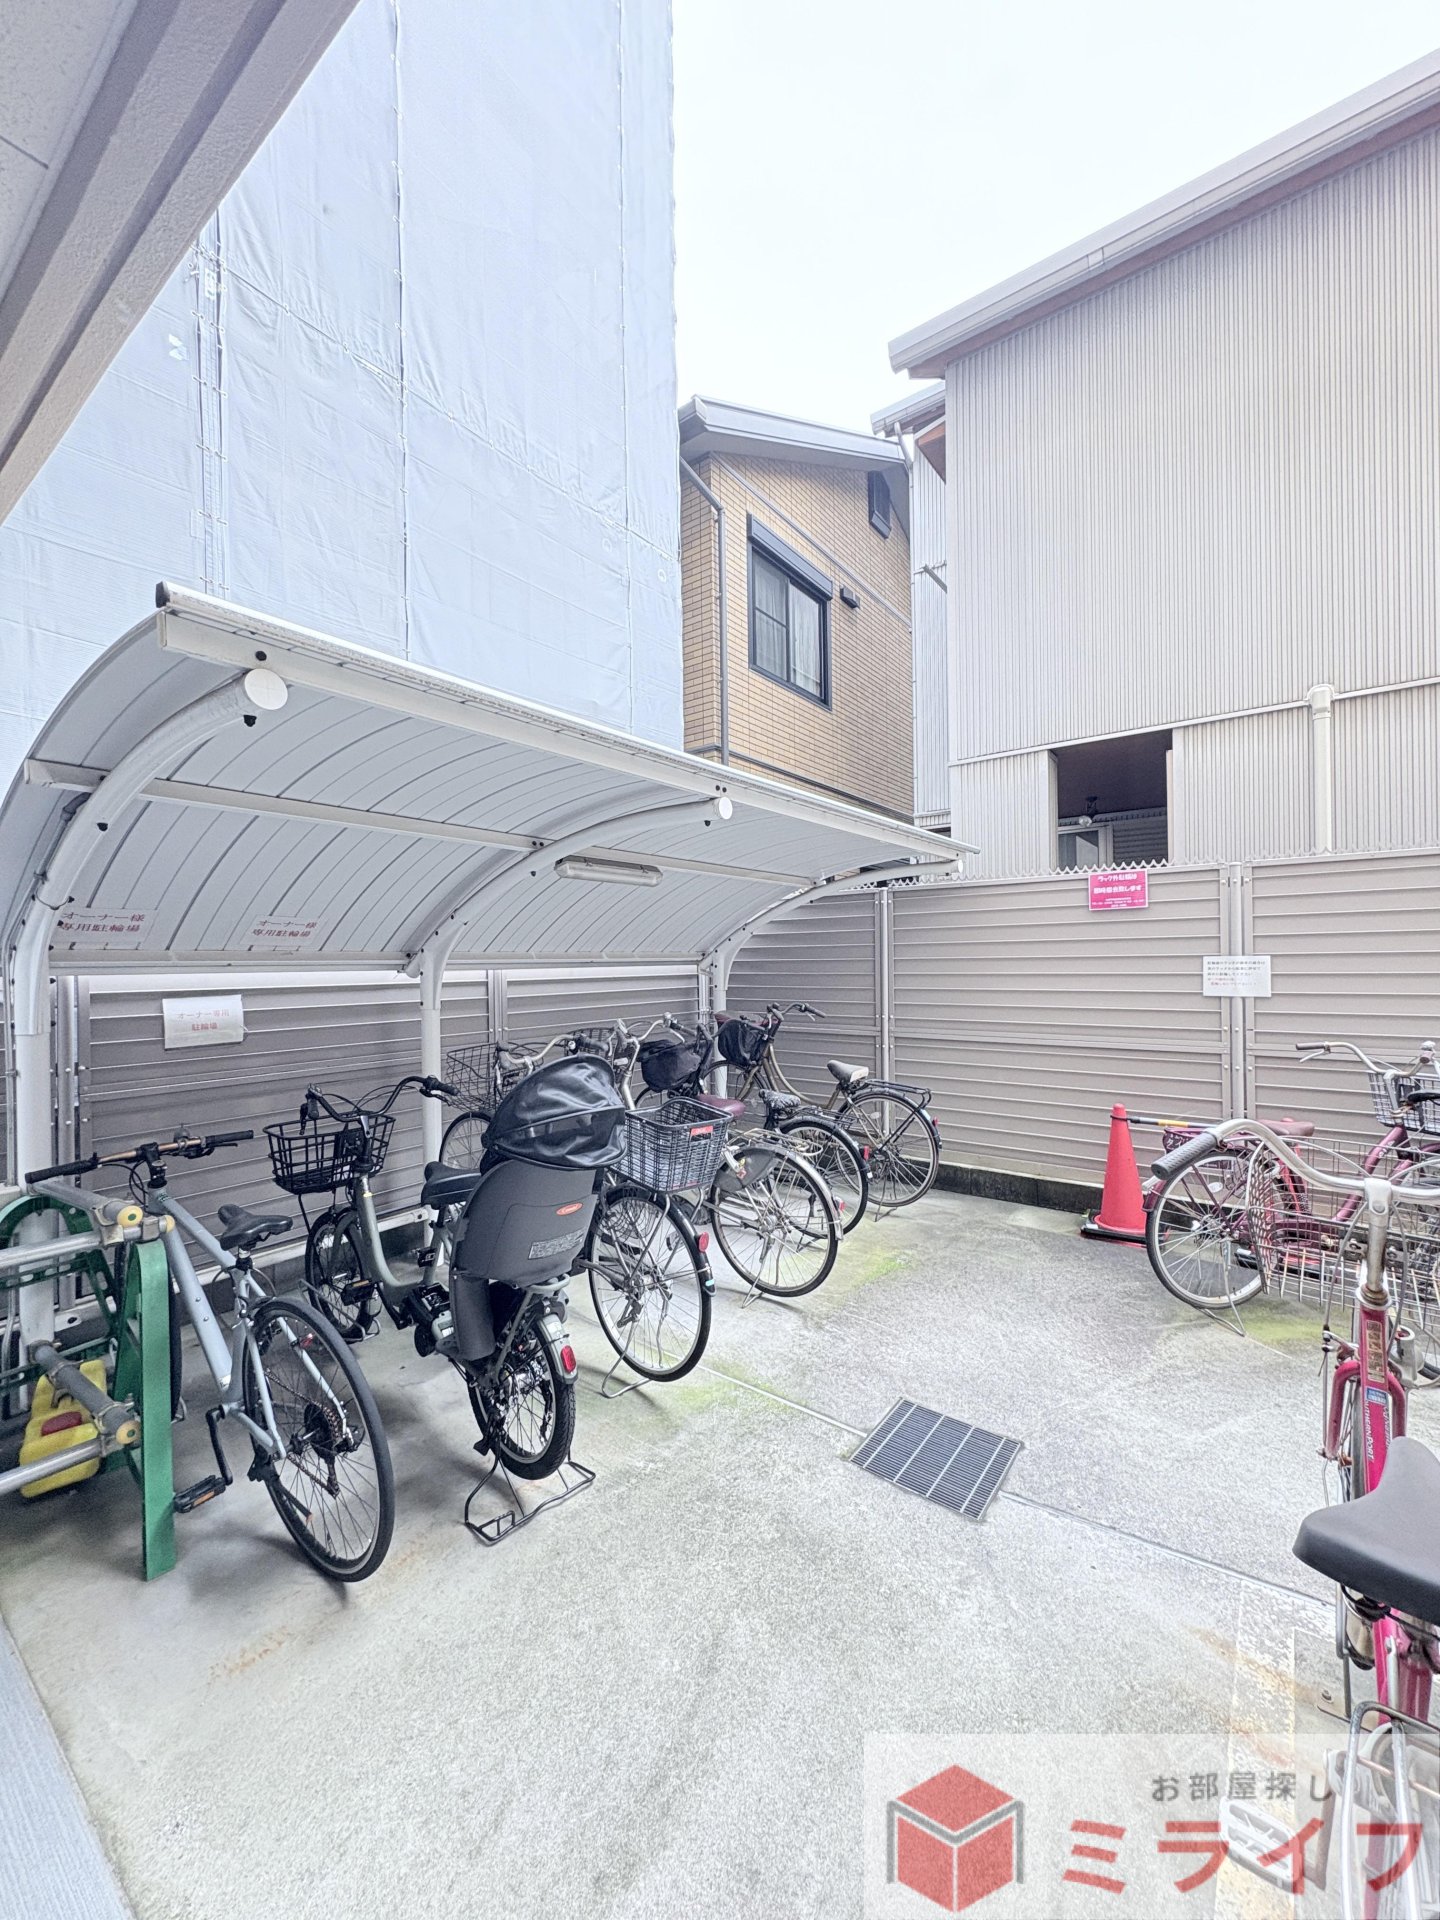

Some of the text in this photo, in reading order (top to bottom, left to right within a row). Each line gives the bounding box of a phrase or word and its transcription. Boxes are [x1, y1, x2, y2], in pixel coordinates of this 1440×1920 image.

[61, 911, 145, 922] オーナー様
